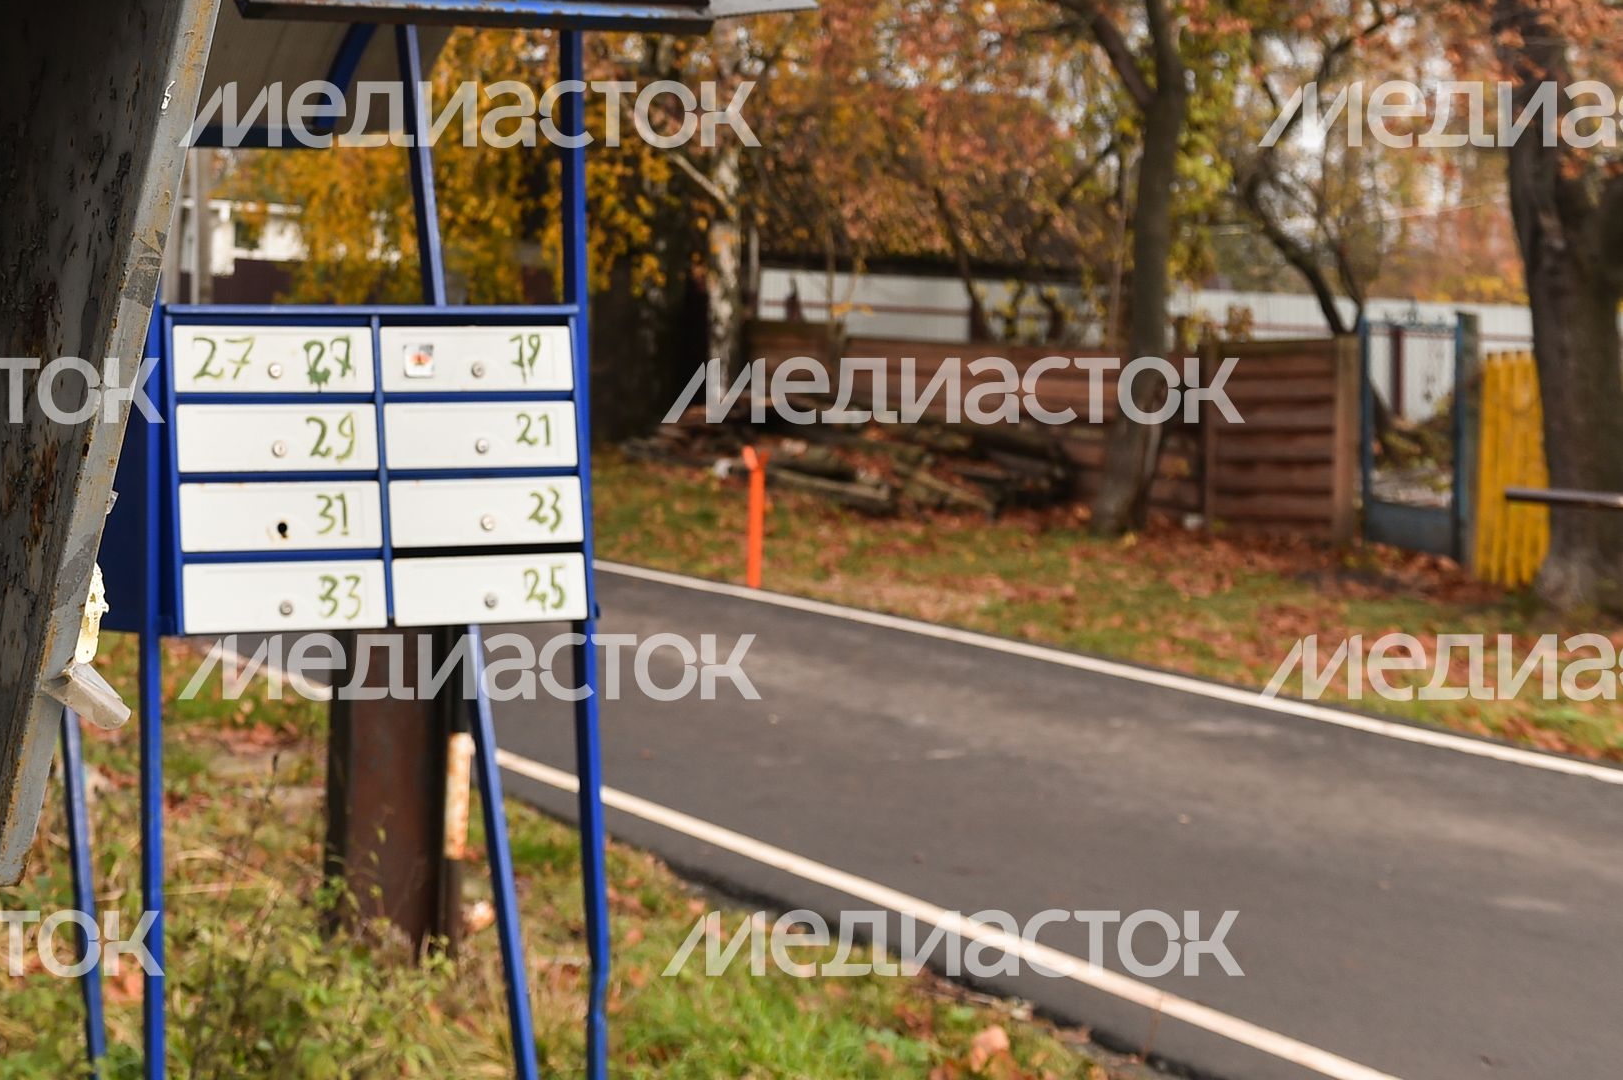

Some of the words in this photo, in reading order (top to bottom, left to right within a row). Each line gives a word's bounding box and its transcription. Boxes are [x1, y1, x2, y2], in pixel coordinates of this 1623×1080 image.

[192, 336, 255, 381] 27
[304, 412, 356, 464] 29
[515, 413, 552, 448] 21
[315, 492, 350, 537] 31
[527, 486, 563, 534] 23
[317, 573, 362, 620] 33
[522, 564, 567, 612] 25
